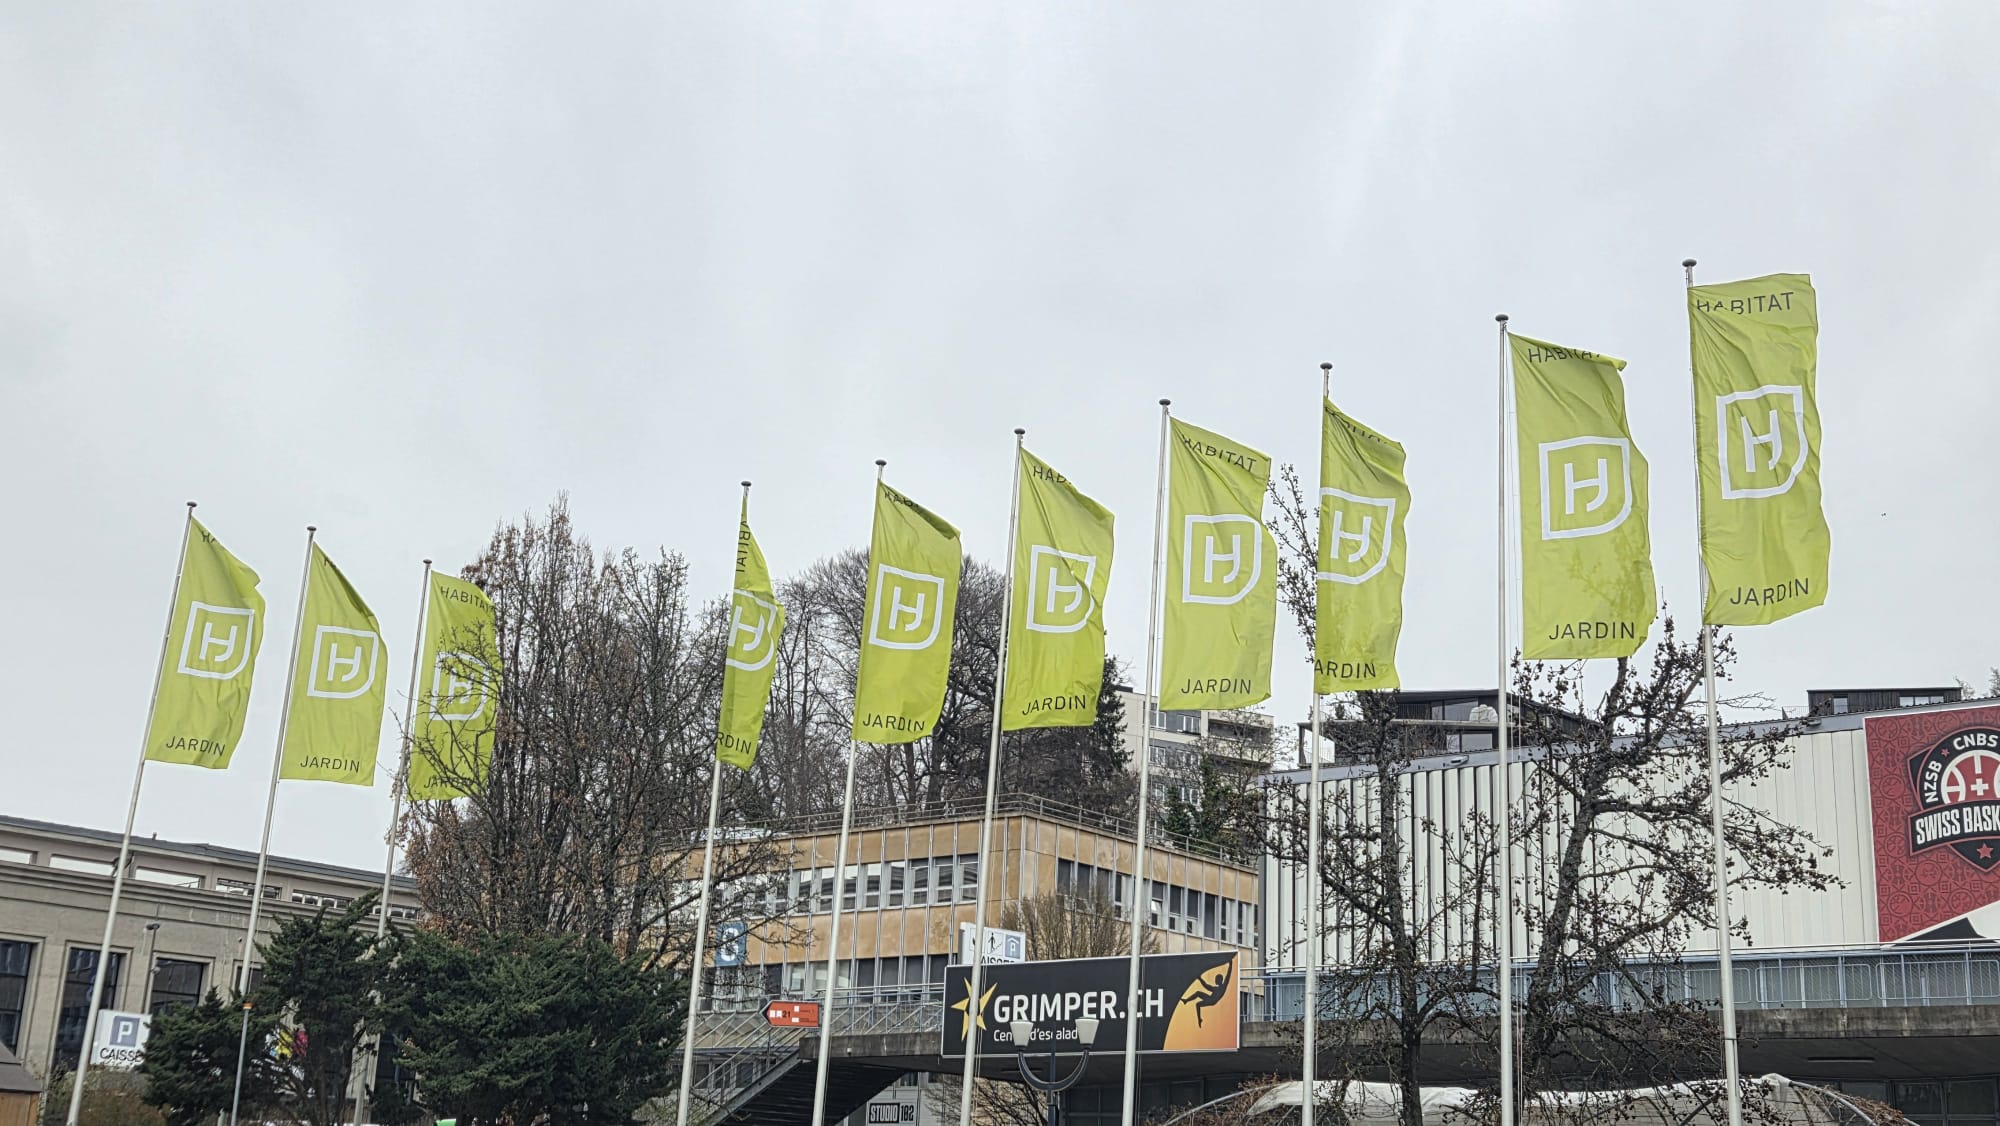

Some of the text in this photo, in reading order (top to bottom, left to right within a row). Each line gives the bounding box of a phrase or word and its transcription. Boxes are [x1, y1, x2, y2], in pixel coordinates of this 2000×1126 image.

[1696, 292, 1794, 315] HABITAT
[1730, 577, 1810, 606] JARDIN
[1549, 621, 1635, 640] JARDIN
[1314, 659, 1376, 679] ARDIN
[1181, 678, 1252, 695] JARDIN
[1022, 694, 1087, 716] JARDIN
[862, 713, 926, 732] JARDIN
[166, 735, 226, 757] JARDIN
[717, 731, 752, 755] RDIN
[1953, 733, 1999, 750] CNBS
[300, 755, 361, 774] JARDIN
[1923, 760, 1942, 803] NZSB
[1915, 807, 1961, 845] SWISS
[117, 1021, 133, 1043] P
[993, 1029, 1014, 1042] Cen
[870, 1104, 898, 1122] STUDIO
